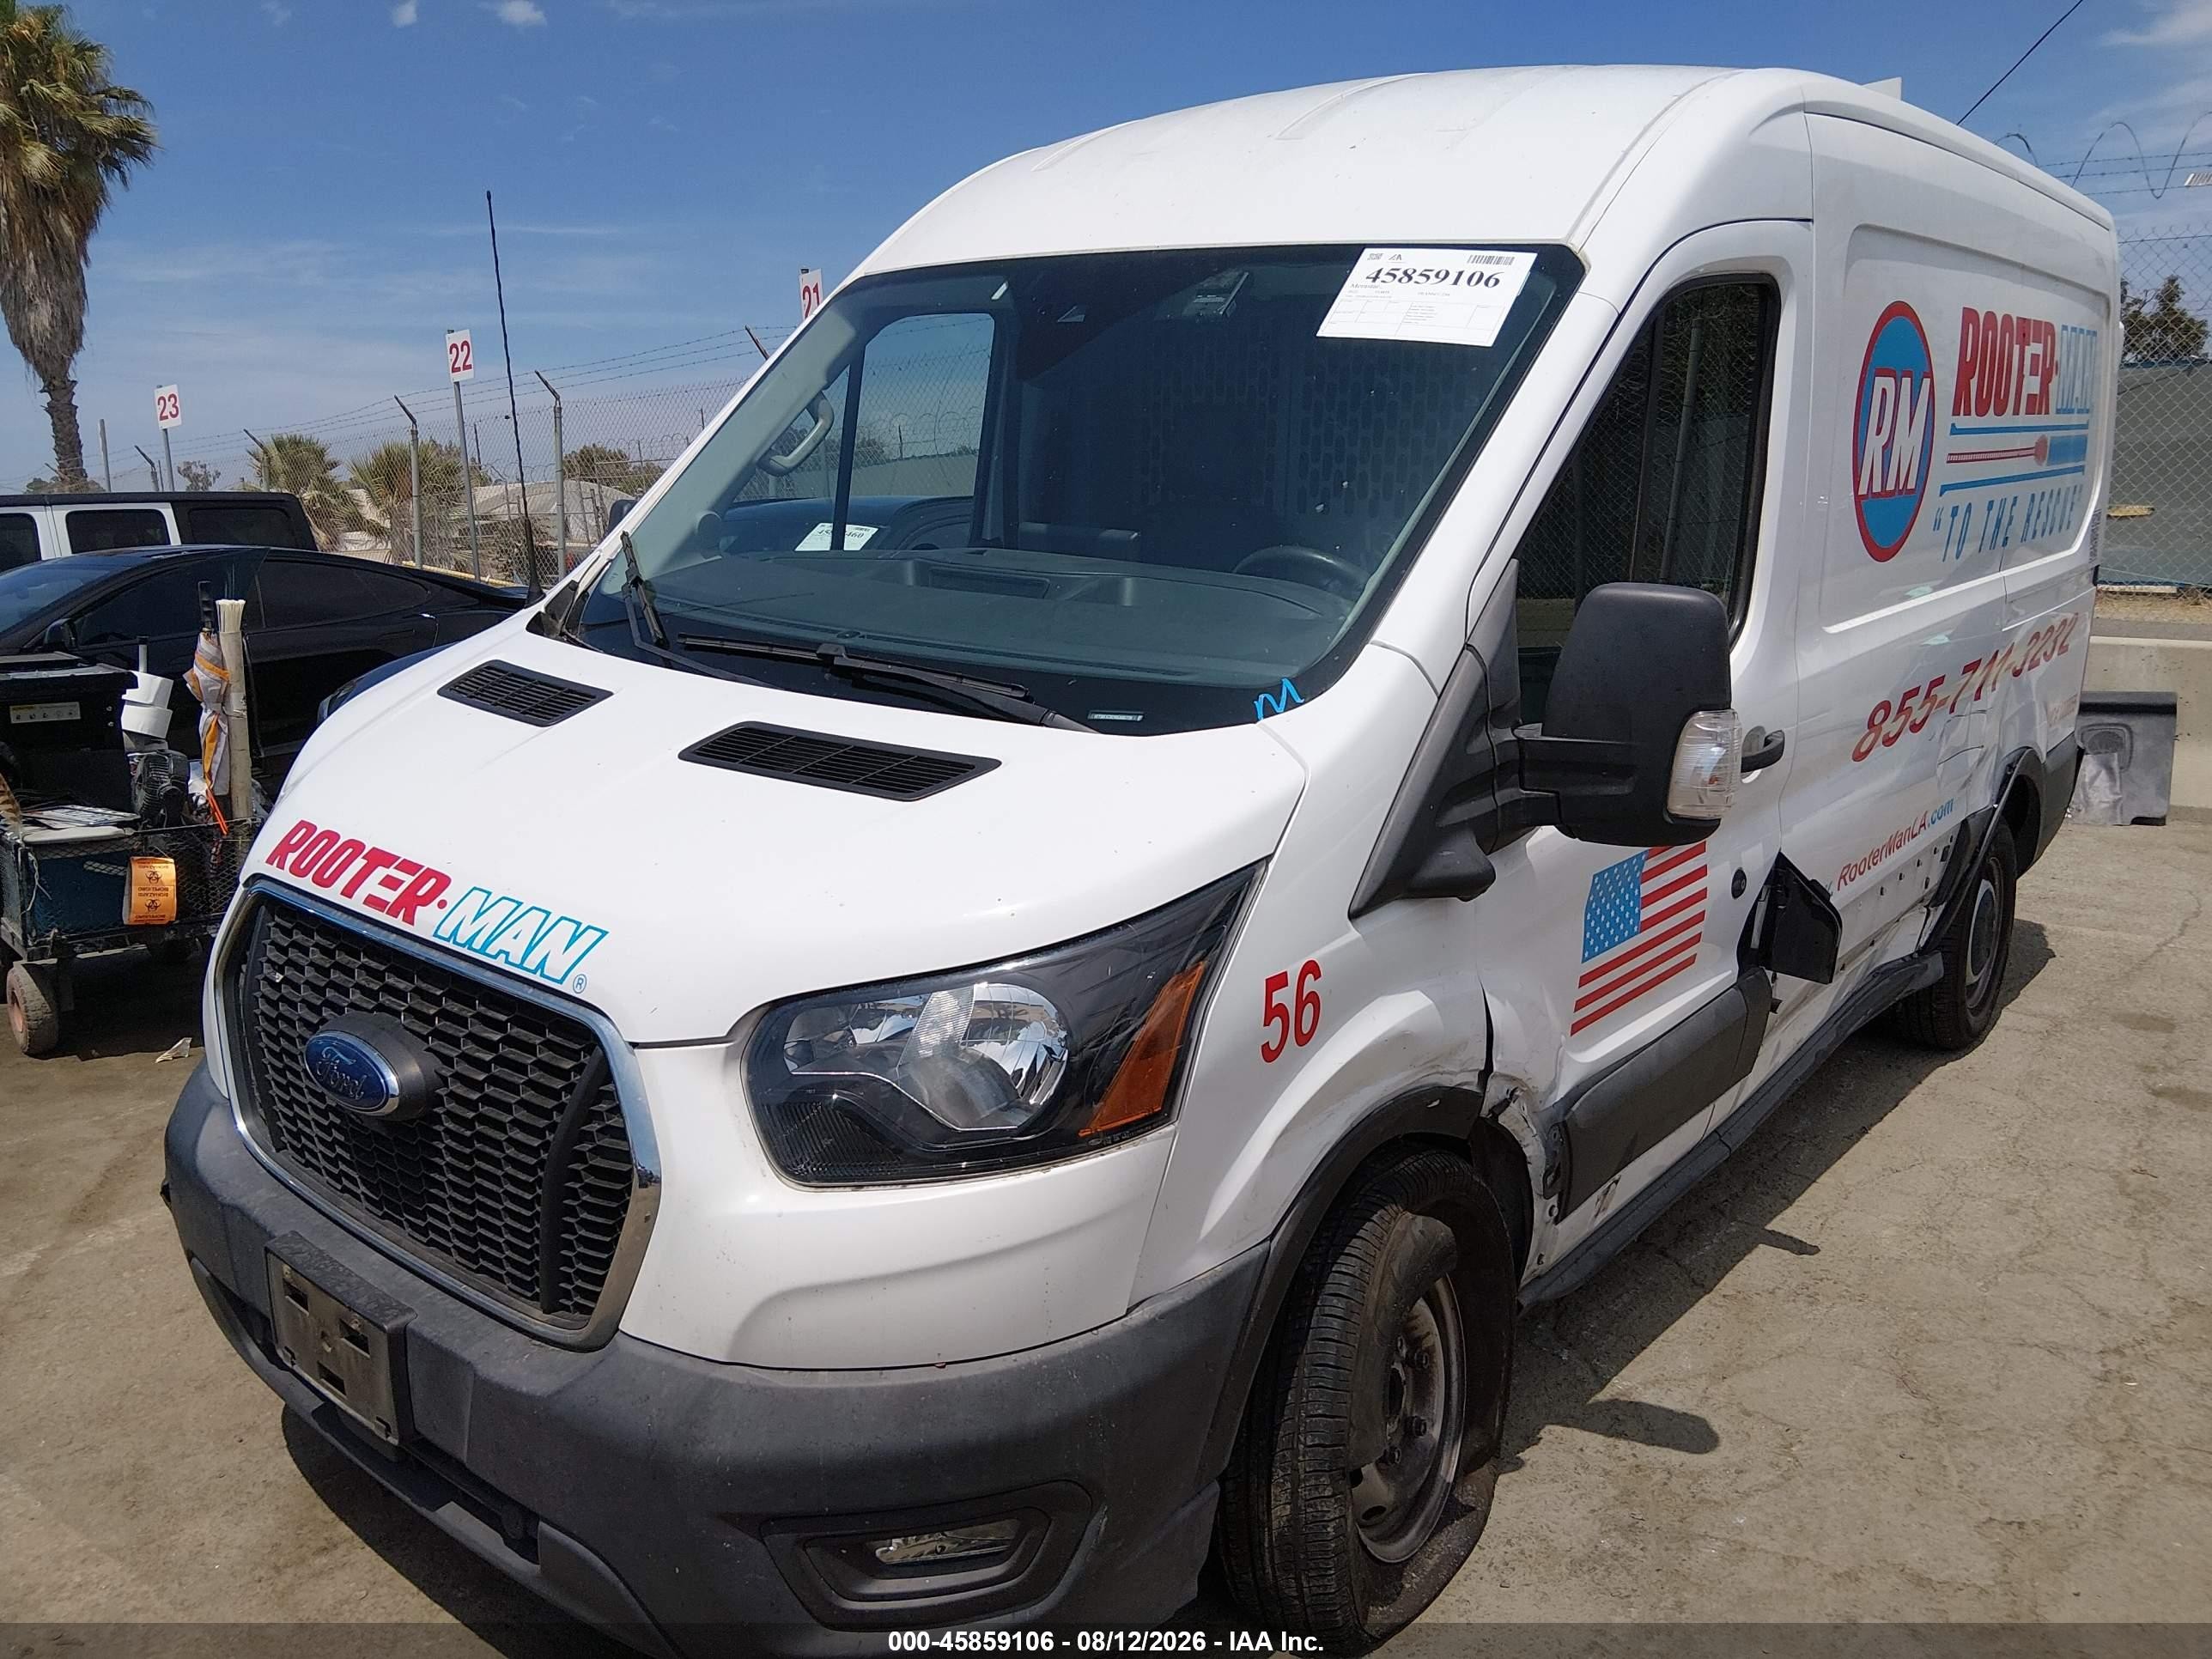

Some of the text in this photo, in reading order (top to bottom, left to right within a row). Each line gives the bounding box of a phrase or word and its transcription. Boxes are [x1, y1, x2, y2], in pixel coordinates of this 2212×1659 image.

[802, 282, 820, 319] 21
[1365, 268, 1504, 288] 45859106
[449, 340, 472, 373] 22
[157, 393, 179, 421] 23
[1857, 375, 1931, 495] RM
[1978, 495, 2018, 553] THE
[1851, 612, 2079, 763] 855-711-3232
[1837, 798, 1954, 891] RooterManLA.com
[1261, 959, 1322, 1063] 56
[316, 1046, 368, 1100] Ford
